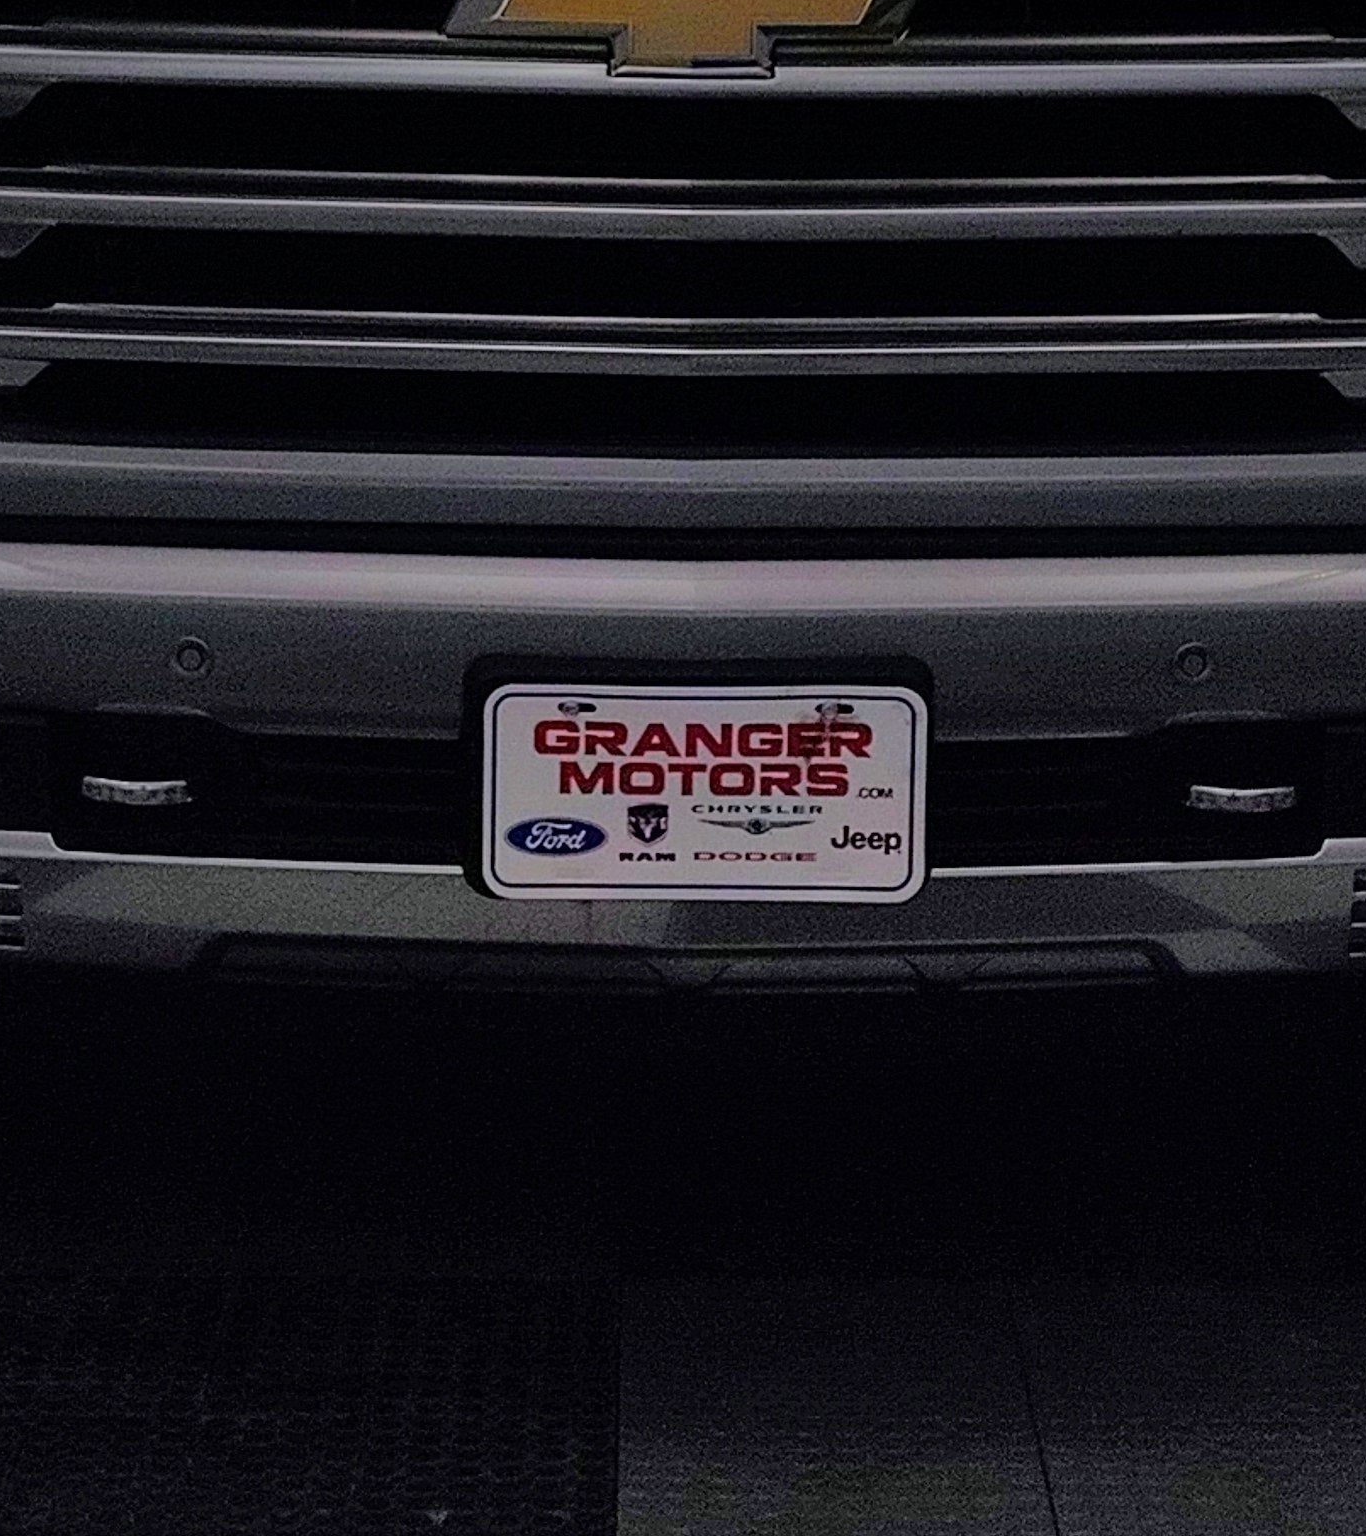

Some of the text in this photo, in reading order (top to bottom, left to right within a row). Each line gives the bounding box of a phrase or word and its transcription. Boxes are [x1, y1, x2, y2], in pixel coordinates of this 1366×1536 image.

[533, 720, 874, 758] GRANGER
[559, 762, 849, 797] MOTORS
[691, 804, 824, 816] CHRYSLER
[525, 823, 586, 850] Ford
[831, 825, 902, 855] Jeep
[619, 852, 676, 862] RAM
[693, 852, 817, 862] DODGE
